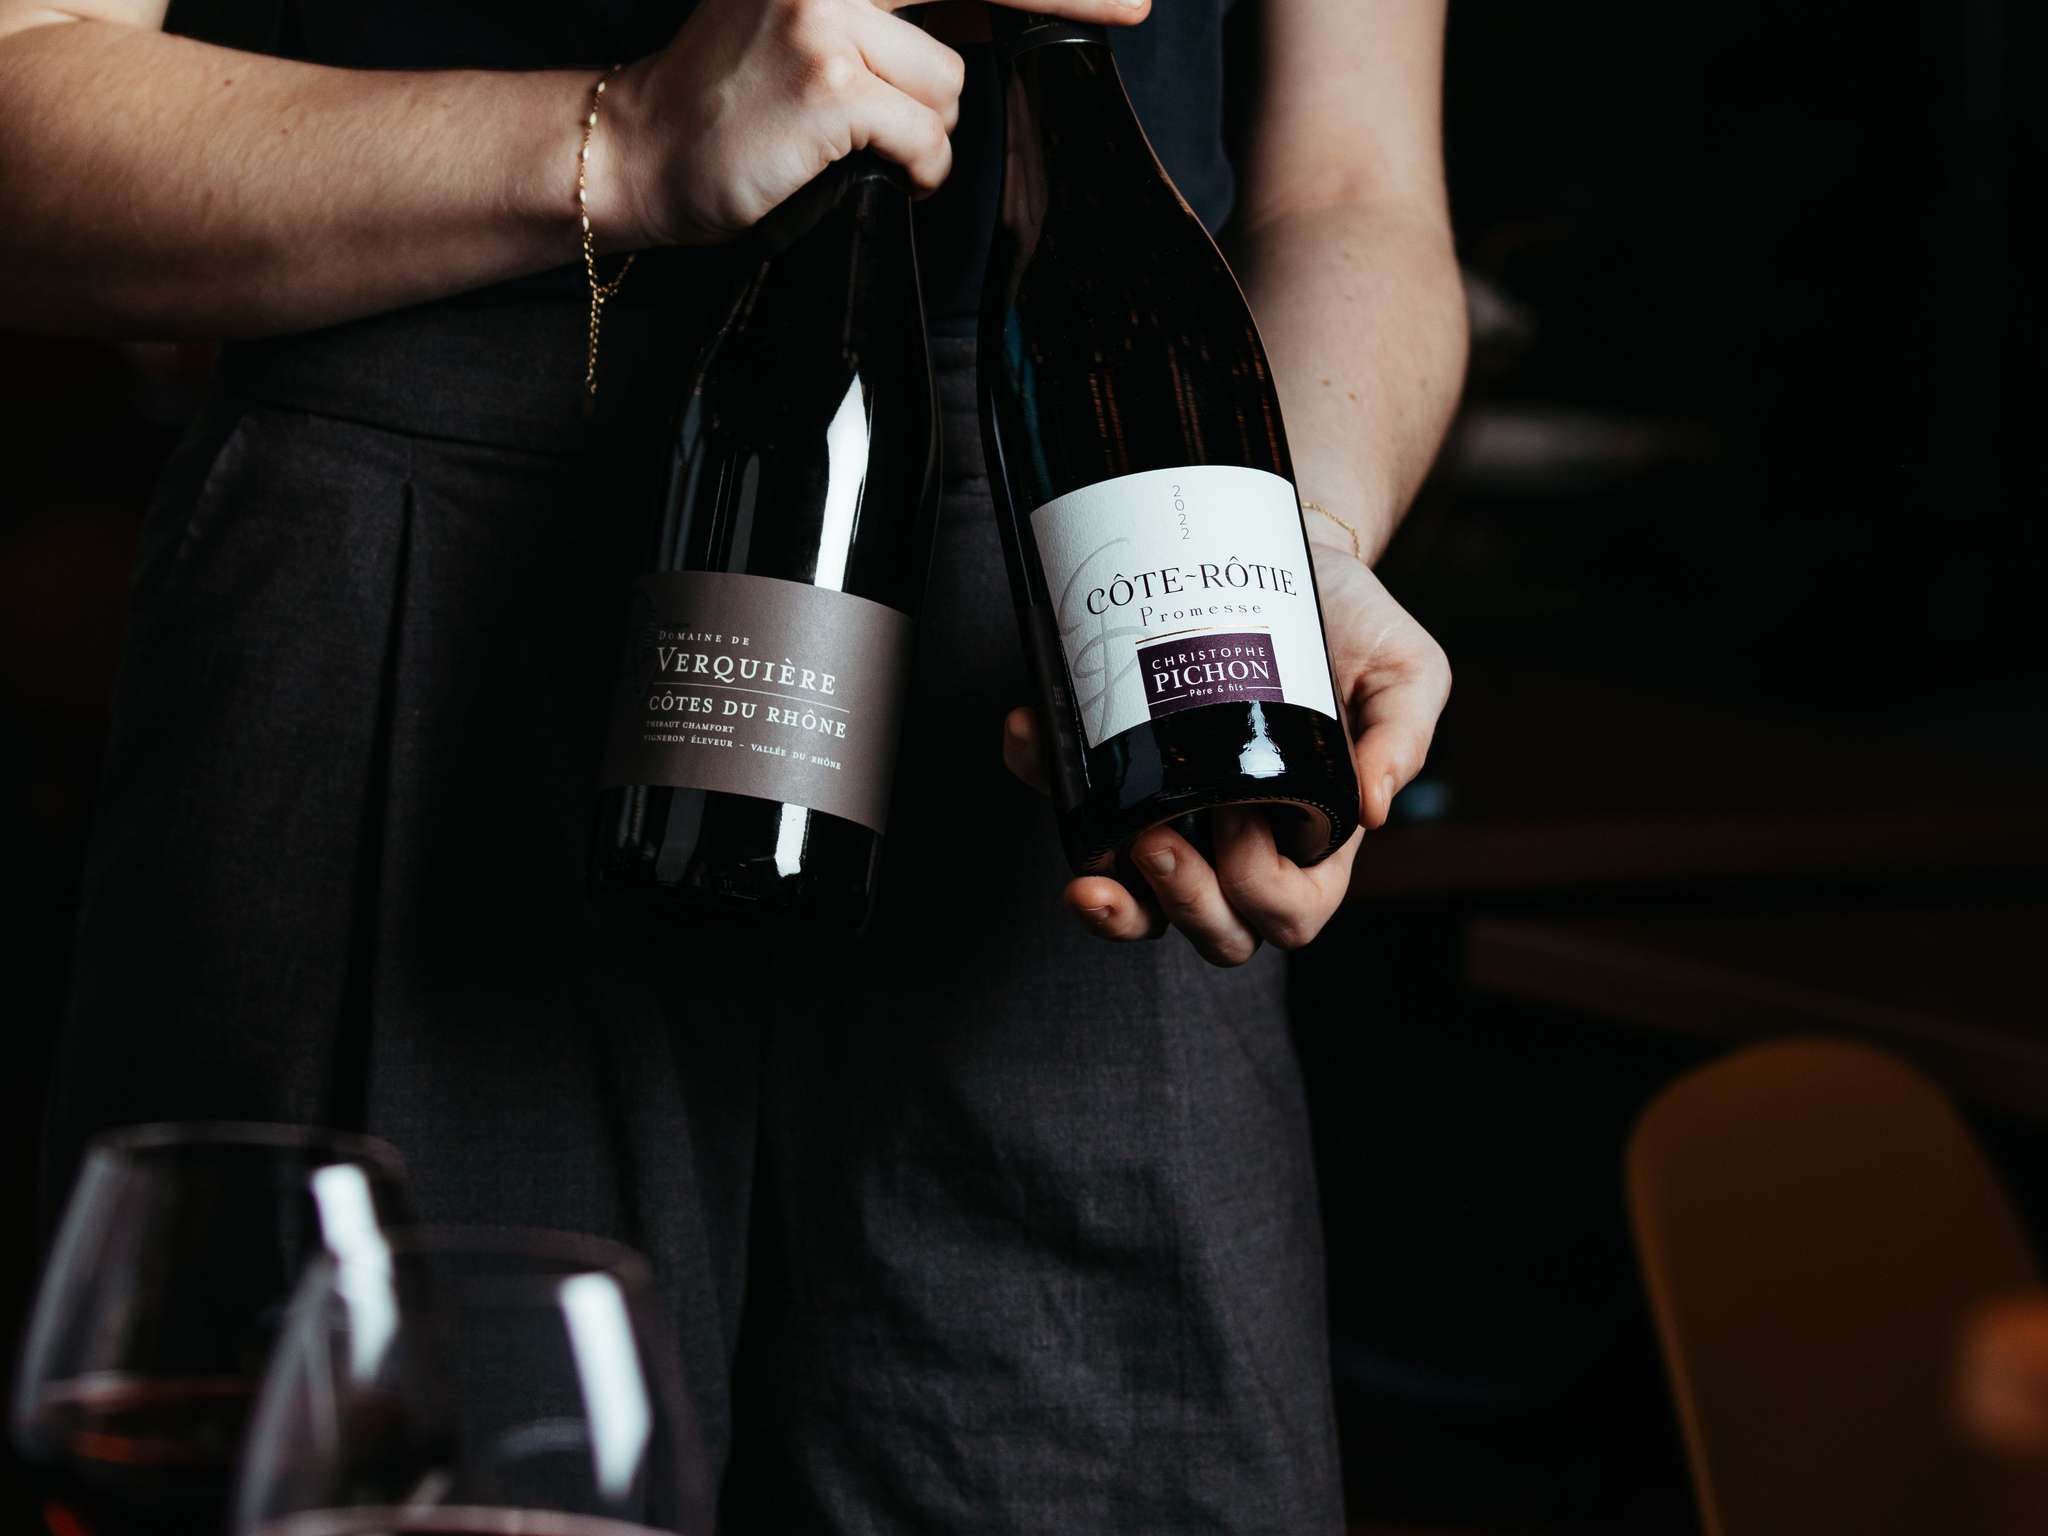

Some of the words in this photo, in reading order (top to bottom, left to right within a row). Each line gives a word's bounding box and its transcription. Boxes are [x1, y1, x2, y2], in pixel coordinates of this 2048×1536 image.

[1171, 484, 1191, 540] 2022
[1140, 604, 1262, 626] Promesse
[658, 631, 722, 643] DOMAINE
[731, 636, 750, 646] DE
[657, 646, 836, 695] VERQUIÈRE
[1152, 647, 1266, 670] CHRISTOPHE
[1153, 660, 1270, 694] PICHON
[1189, 687, 1213, 697] Père
[1217, 684, 1224, 693] &
[1228, 683, 1244, 692] fils
[645, 720, 680, 729] THIBAUT
[682, 721, 735, 733] CHAMFORT
[649, 690, 713, 713] CÔTES
[722, 699, 758, 718] DU
[766, 708, 847, 738] RHÔNE
[644, 734, 685, 743] VIGNERON
[690, 735, 734, 748] ÉLEVEUR
[750, 743, 787, 757] VALLÉE
[792, 751, 806, 761] DU
[811, 755, 842, 770] RHÔNE
